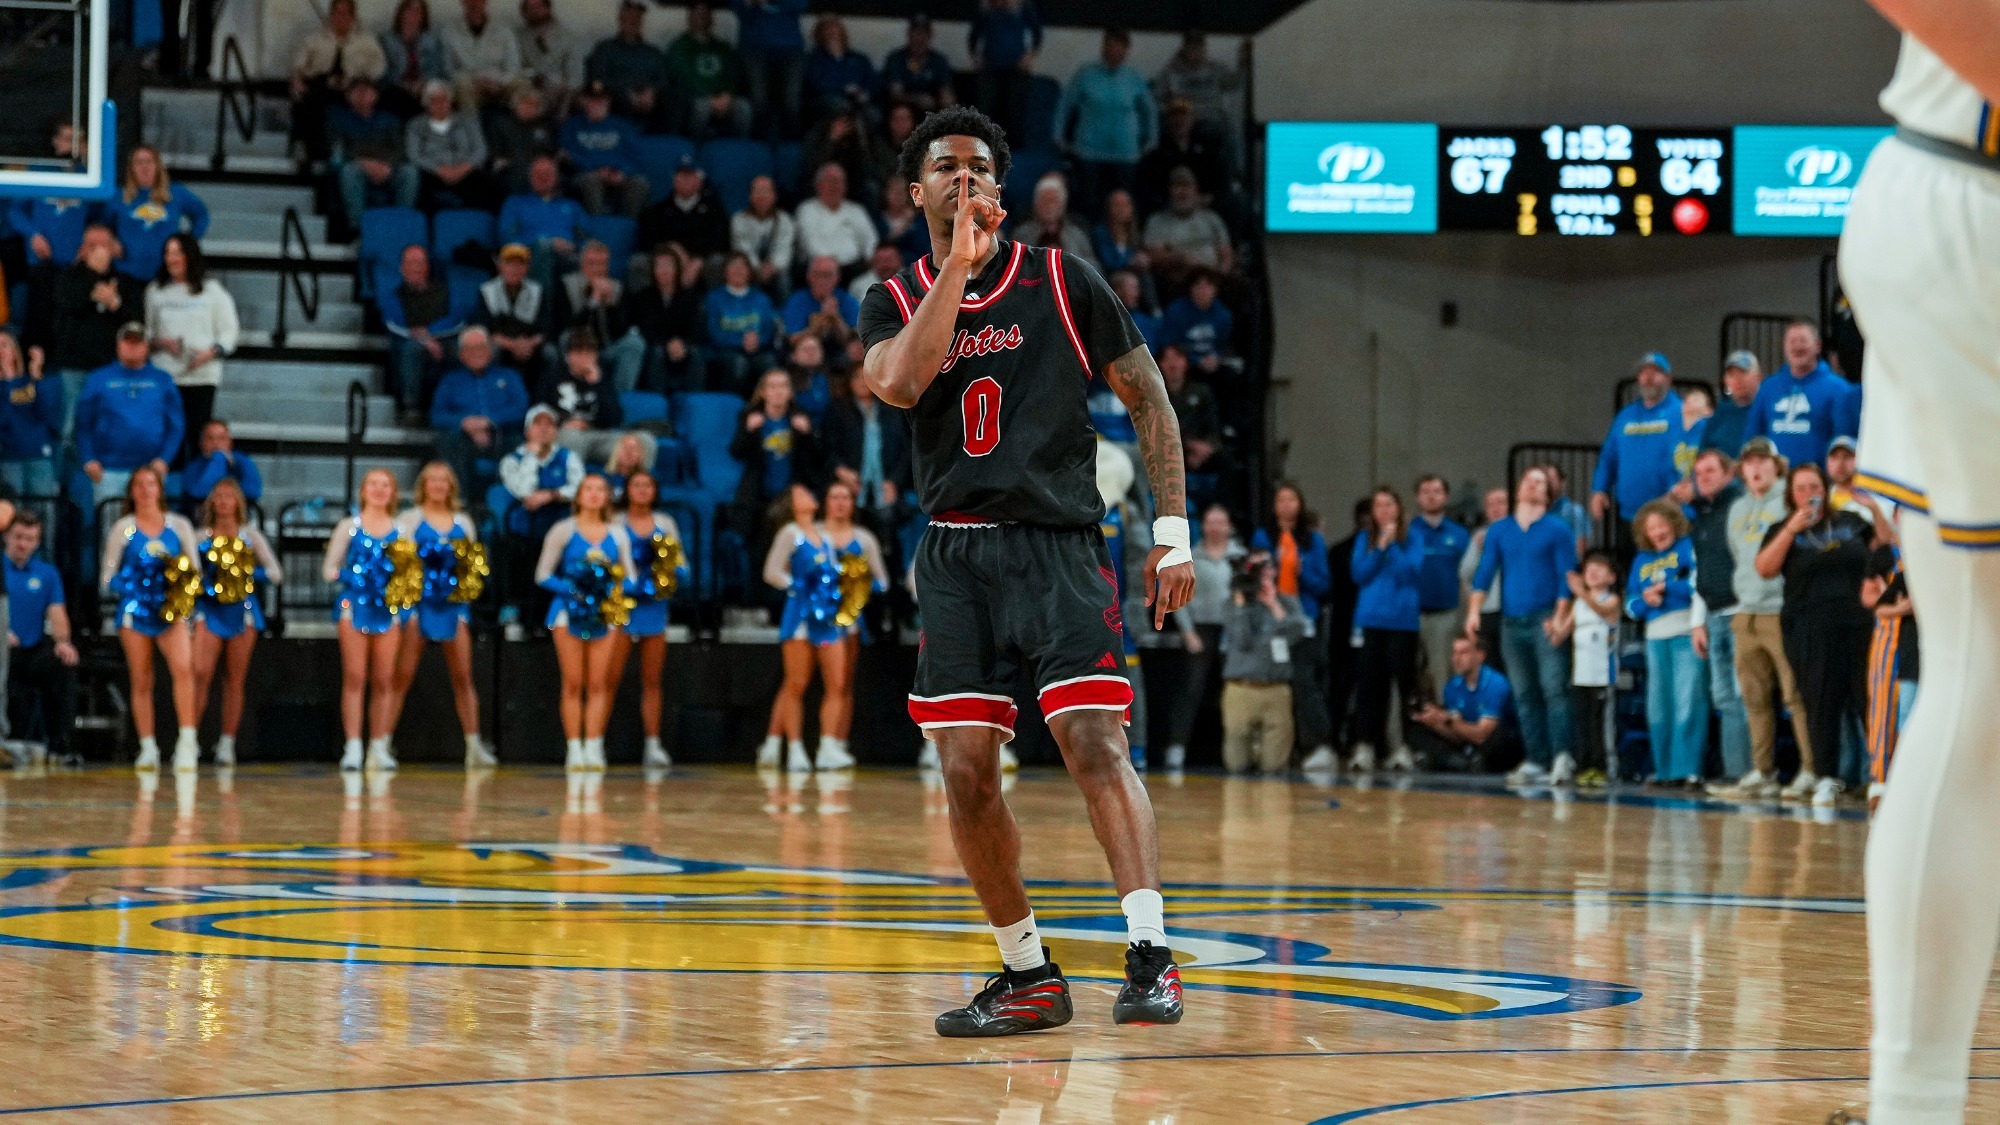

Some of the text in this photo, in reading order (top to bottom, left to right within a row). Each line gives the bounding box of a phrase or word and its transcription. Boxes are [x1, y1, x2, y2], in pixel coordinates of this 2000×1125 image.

[1447, 137, 1516, 158] JACKS
[1542, 125, 1632, 160] 1:52
[1450, 158, 1512, 194] 67
[1559, 165, 1613, 188] 2ND
[1660, 159, 1722, 195] 64
[1517, 193, 1537, 214] 7
[1551, 194, 1621, 215] FOULS
[1637, 216, 1653, 236] 1
[962, 376, 1003, 457] 0
